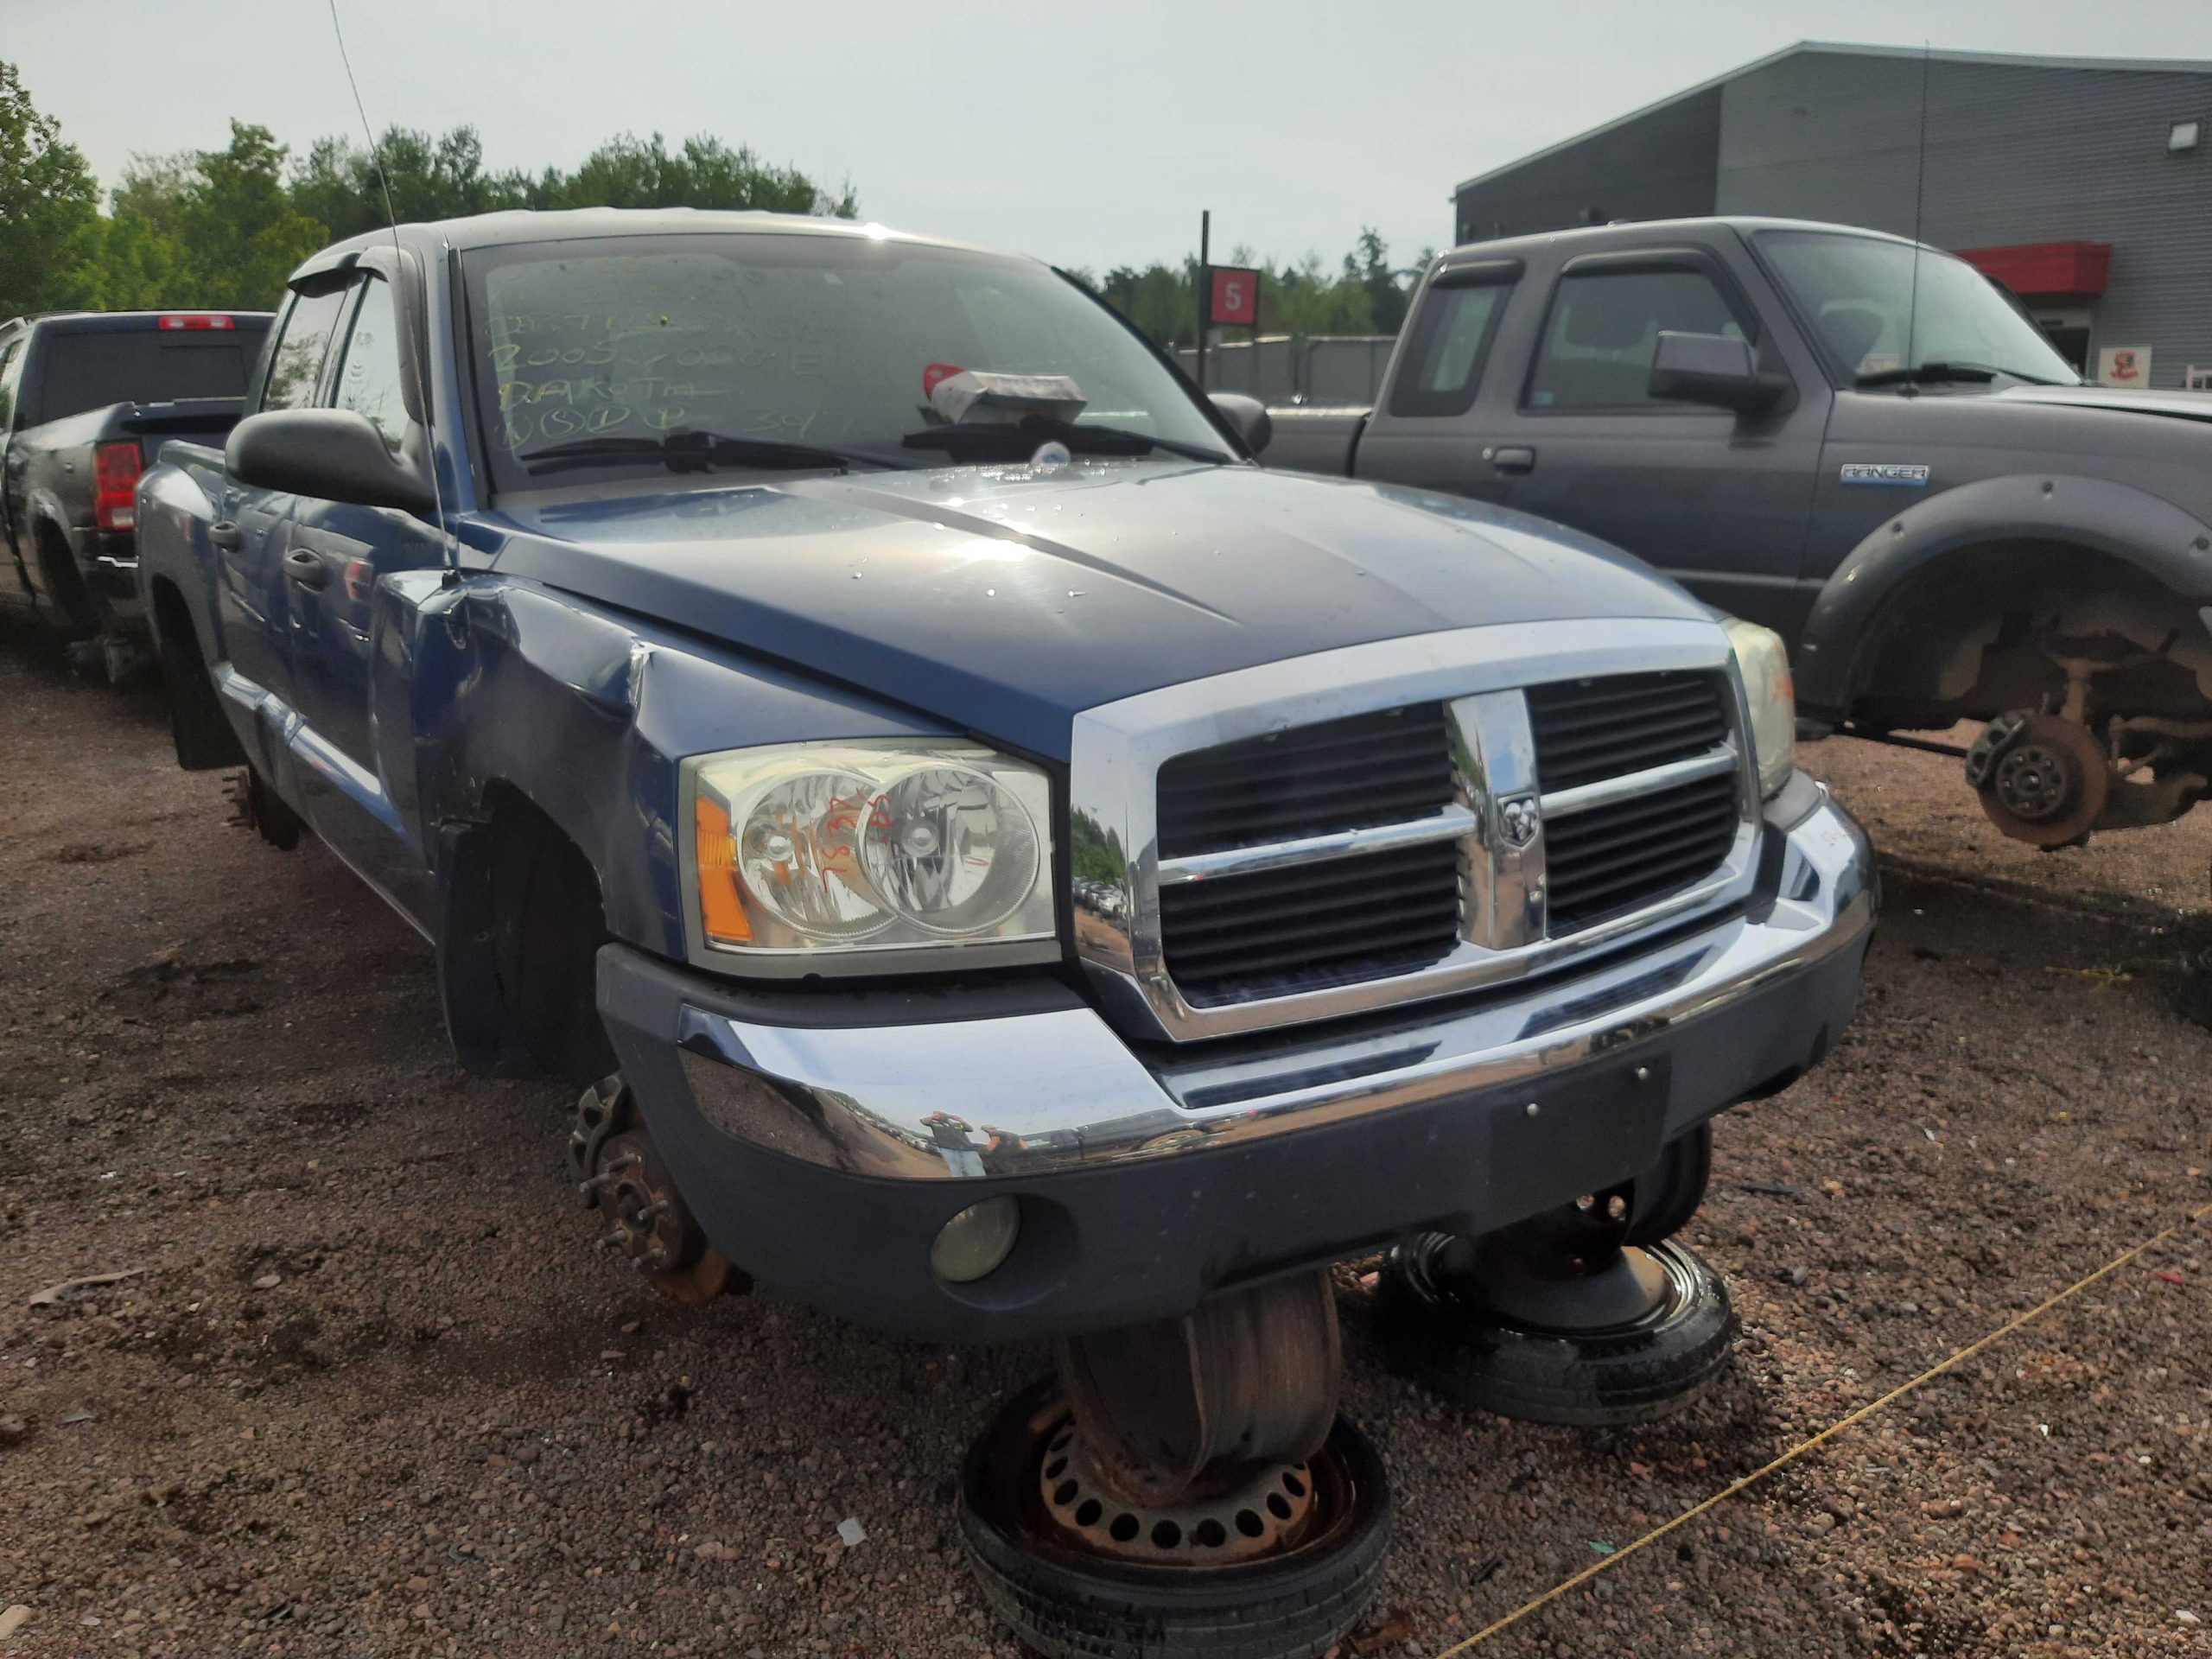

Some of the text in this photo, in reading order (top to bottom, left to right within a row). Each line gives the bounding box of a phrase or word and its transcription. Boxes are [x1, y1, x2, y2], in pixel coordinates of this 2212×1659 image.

[1225, 282, 1242, 310] 5
[488, 339, 618, 372] 2005
[1842, 465, 1927, 481] RANGER
